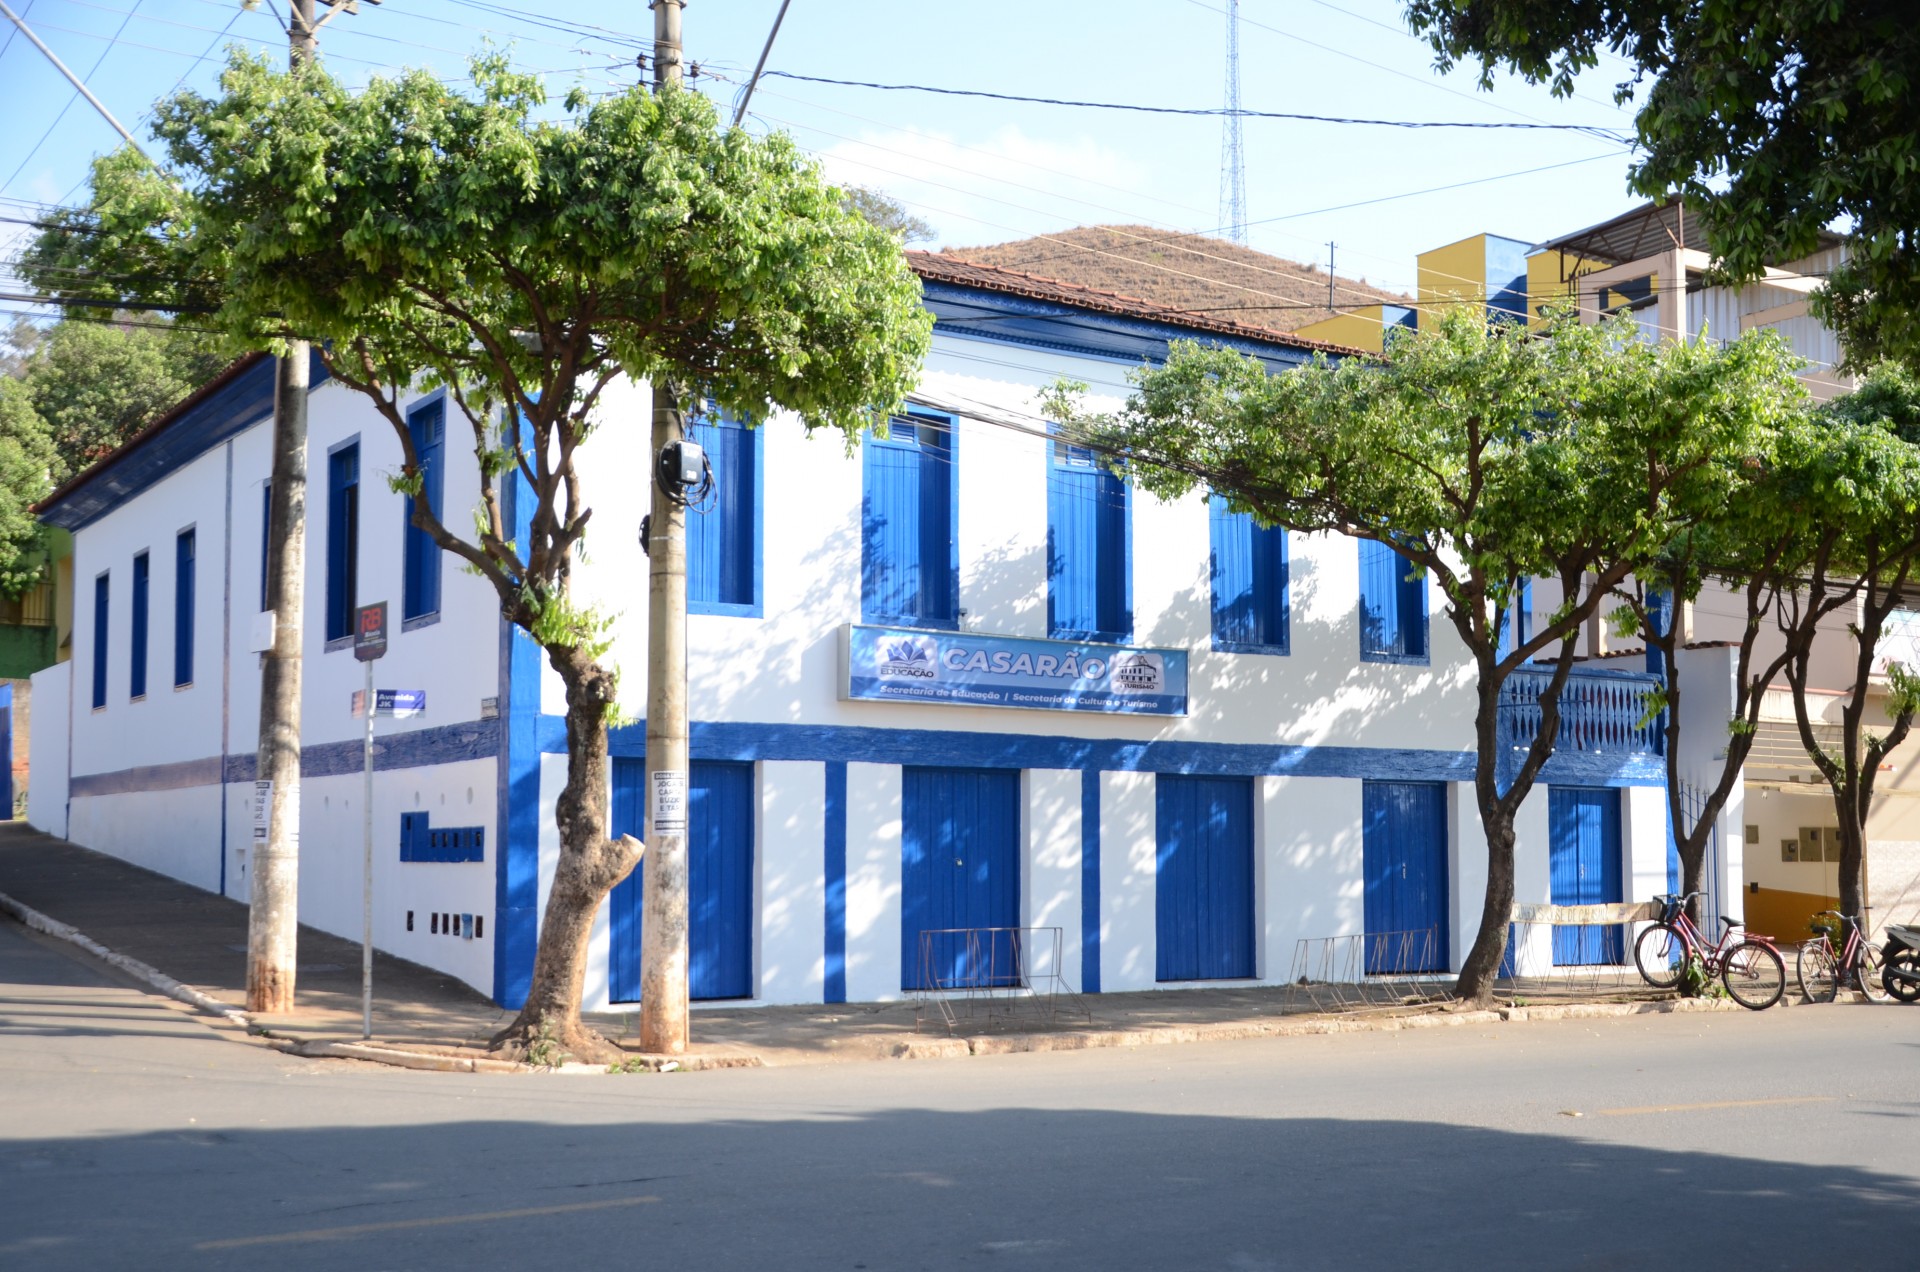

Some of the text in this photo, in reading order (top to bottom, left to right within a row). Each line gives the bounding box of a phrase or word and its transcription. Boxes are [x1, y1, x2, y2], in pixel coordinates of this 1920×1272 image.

[881, 668, 934, 678] EDUCAÇÃO
[943, 648, 1106, 680] CASARÃO
[880, 685, 934, 696] Secretaria
[936, 688, 949, 697] de
[951, 689, 1000, 701] Educação
[1012, 692, 1062, 704] Secretaria
[1064, 696, 1076, 704] de
[1078, 697, 1111, 706] Cultura
[1122, 700, 1158, 709] Turismo
